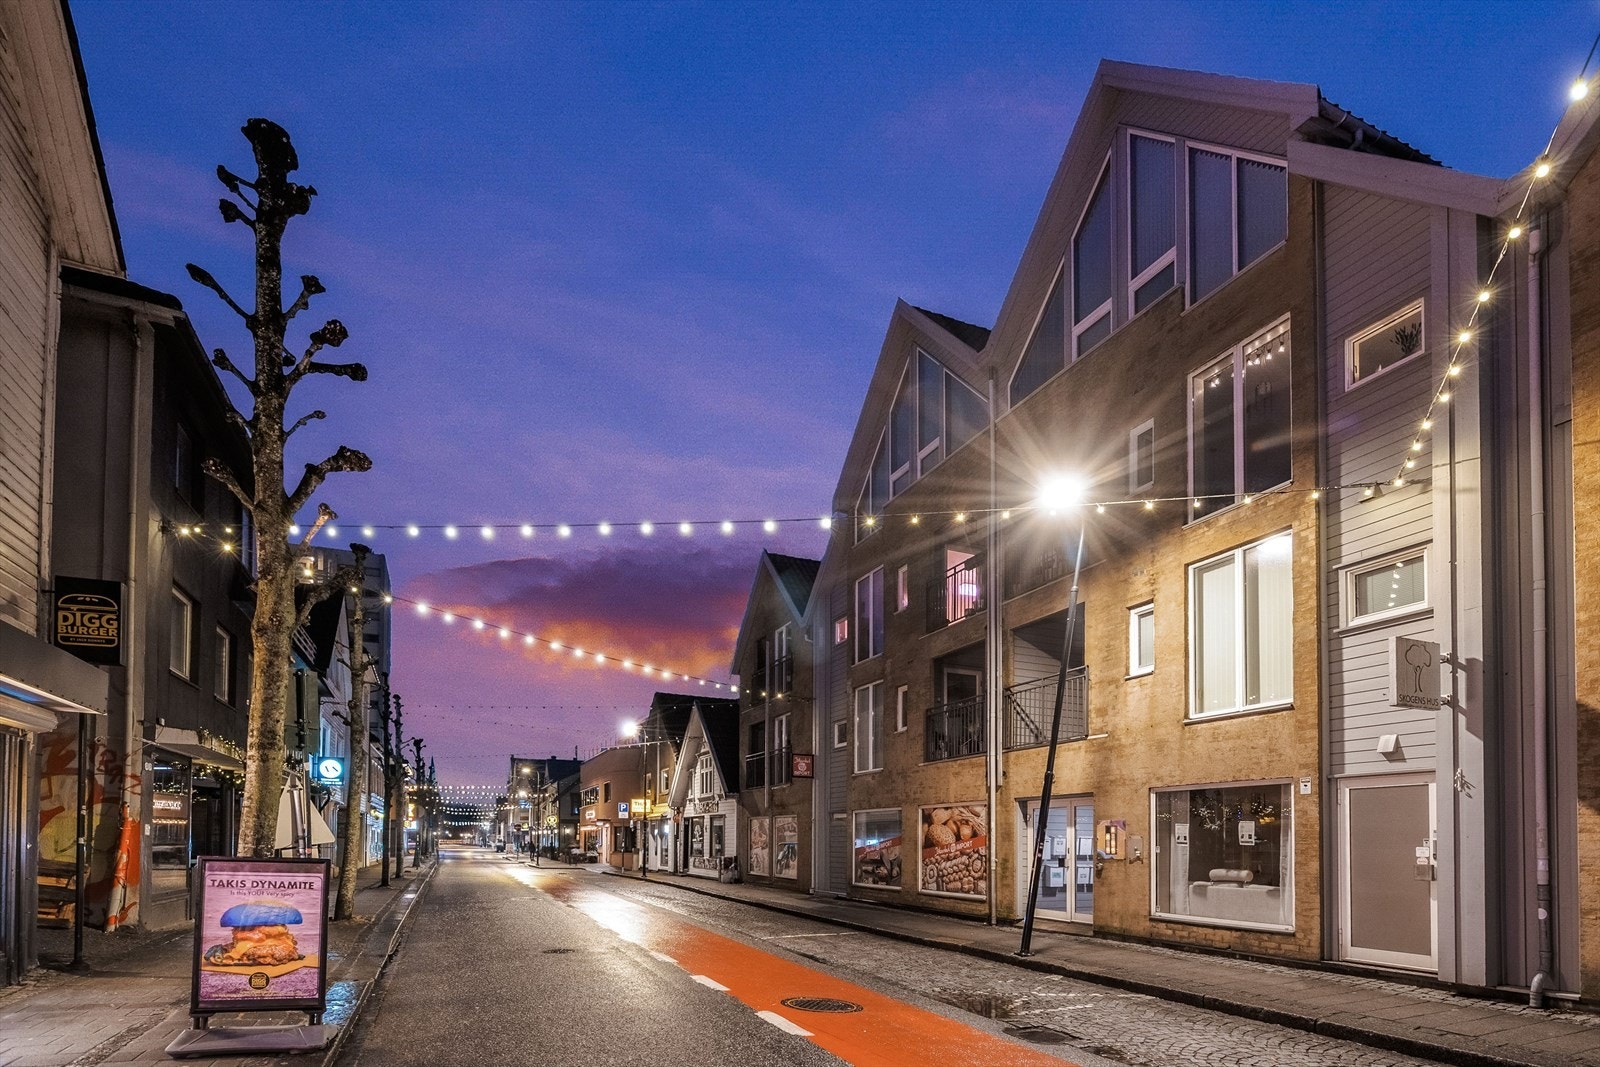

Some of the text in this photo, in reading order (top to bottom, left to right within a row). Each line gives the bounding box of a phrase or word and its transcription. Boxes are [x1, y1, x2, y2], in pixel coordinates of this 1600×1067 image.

[58, 612, 118, 628] DIGG
[58, 625, 118, 636] BURGER
[1398, 694, 1439, 707] SKOGENS HUS
[210, 879, 315, 890] TAKIS DYNAMITE
